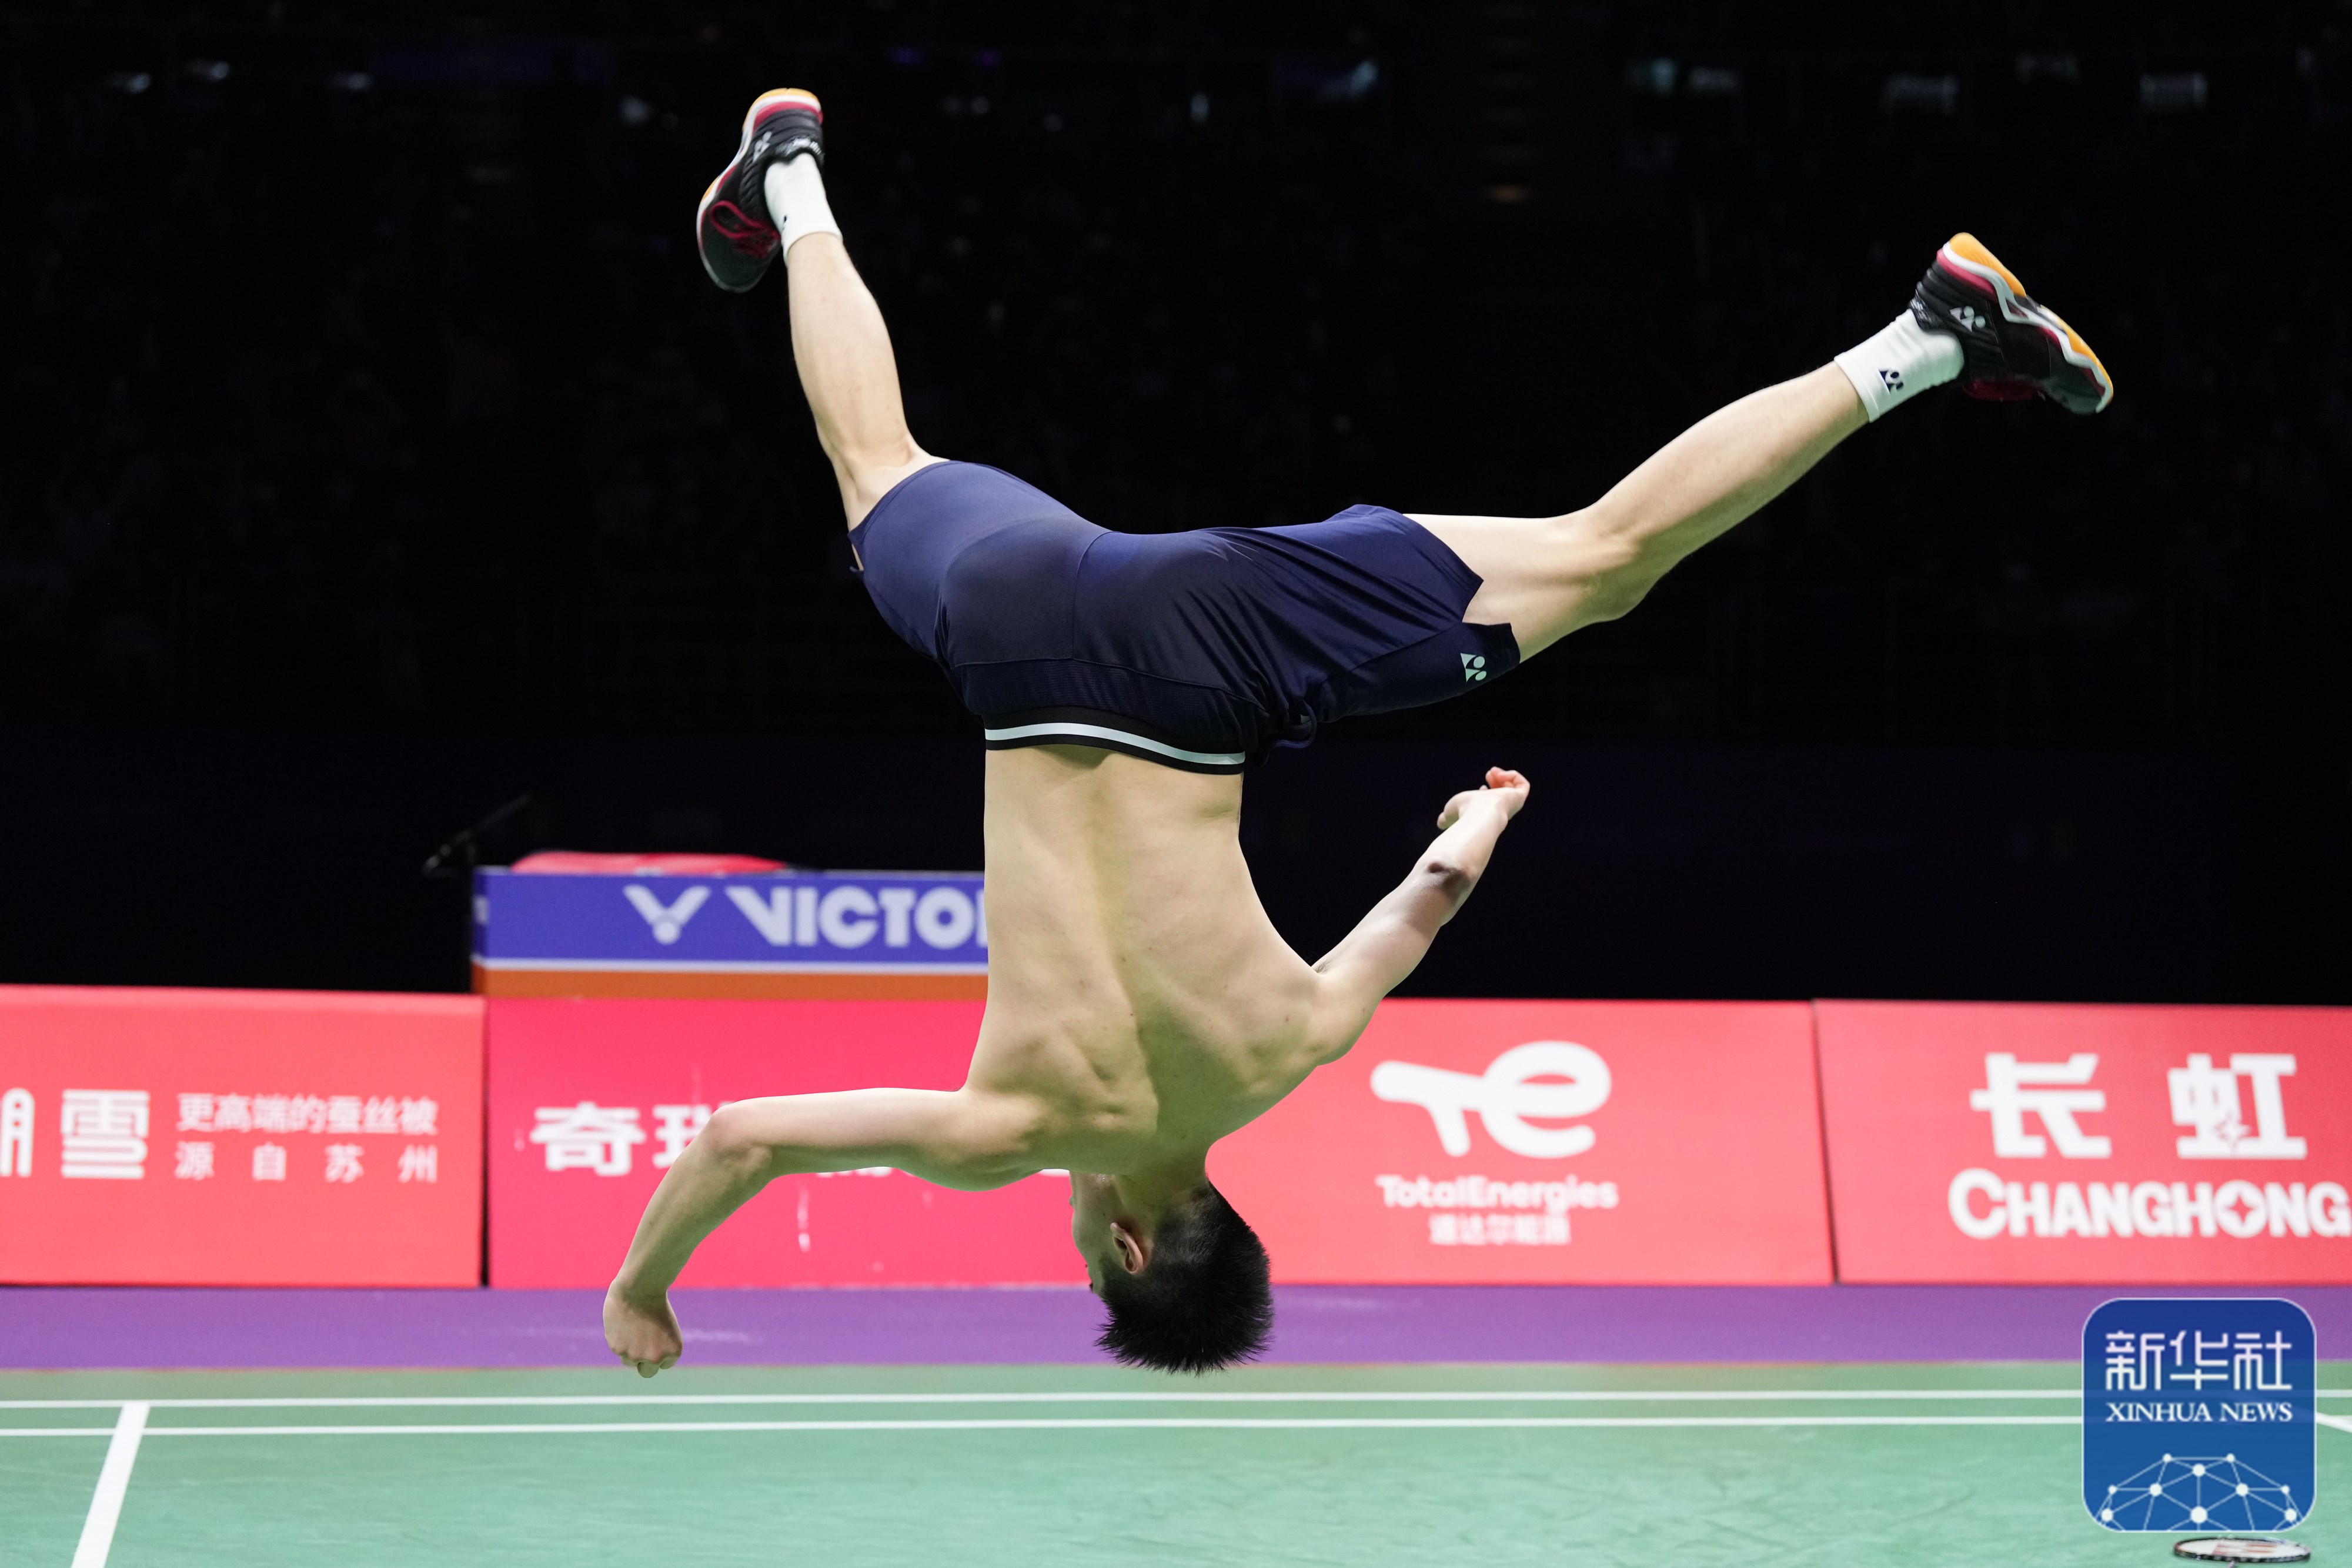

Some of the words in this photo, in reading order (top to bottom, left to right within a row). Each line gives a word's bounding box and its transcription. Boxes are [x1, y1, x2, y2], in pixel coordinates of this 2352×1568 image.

[725, 885, 987, 948] VICTO
[177, 1092, 439, 1135] 更高端的蚕丝被
[1970, 1052, 2306, 1159] 长虹
[175, 1141, 438, 1183] 源自苏州
[1375, 1174, 1618, 1214] TotalEnergies
